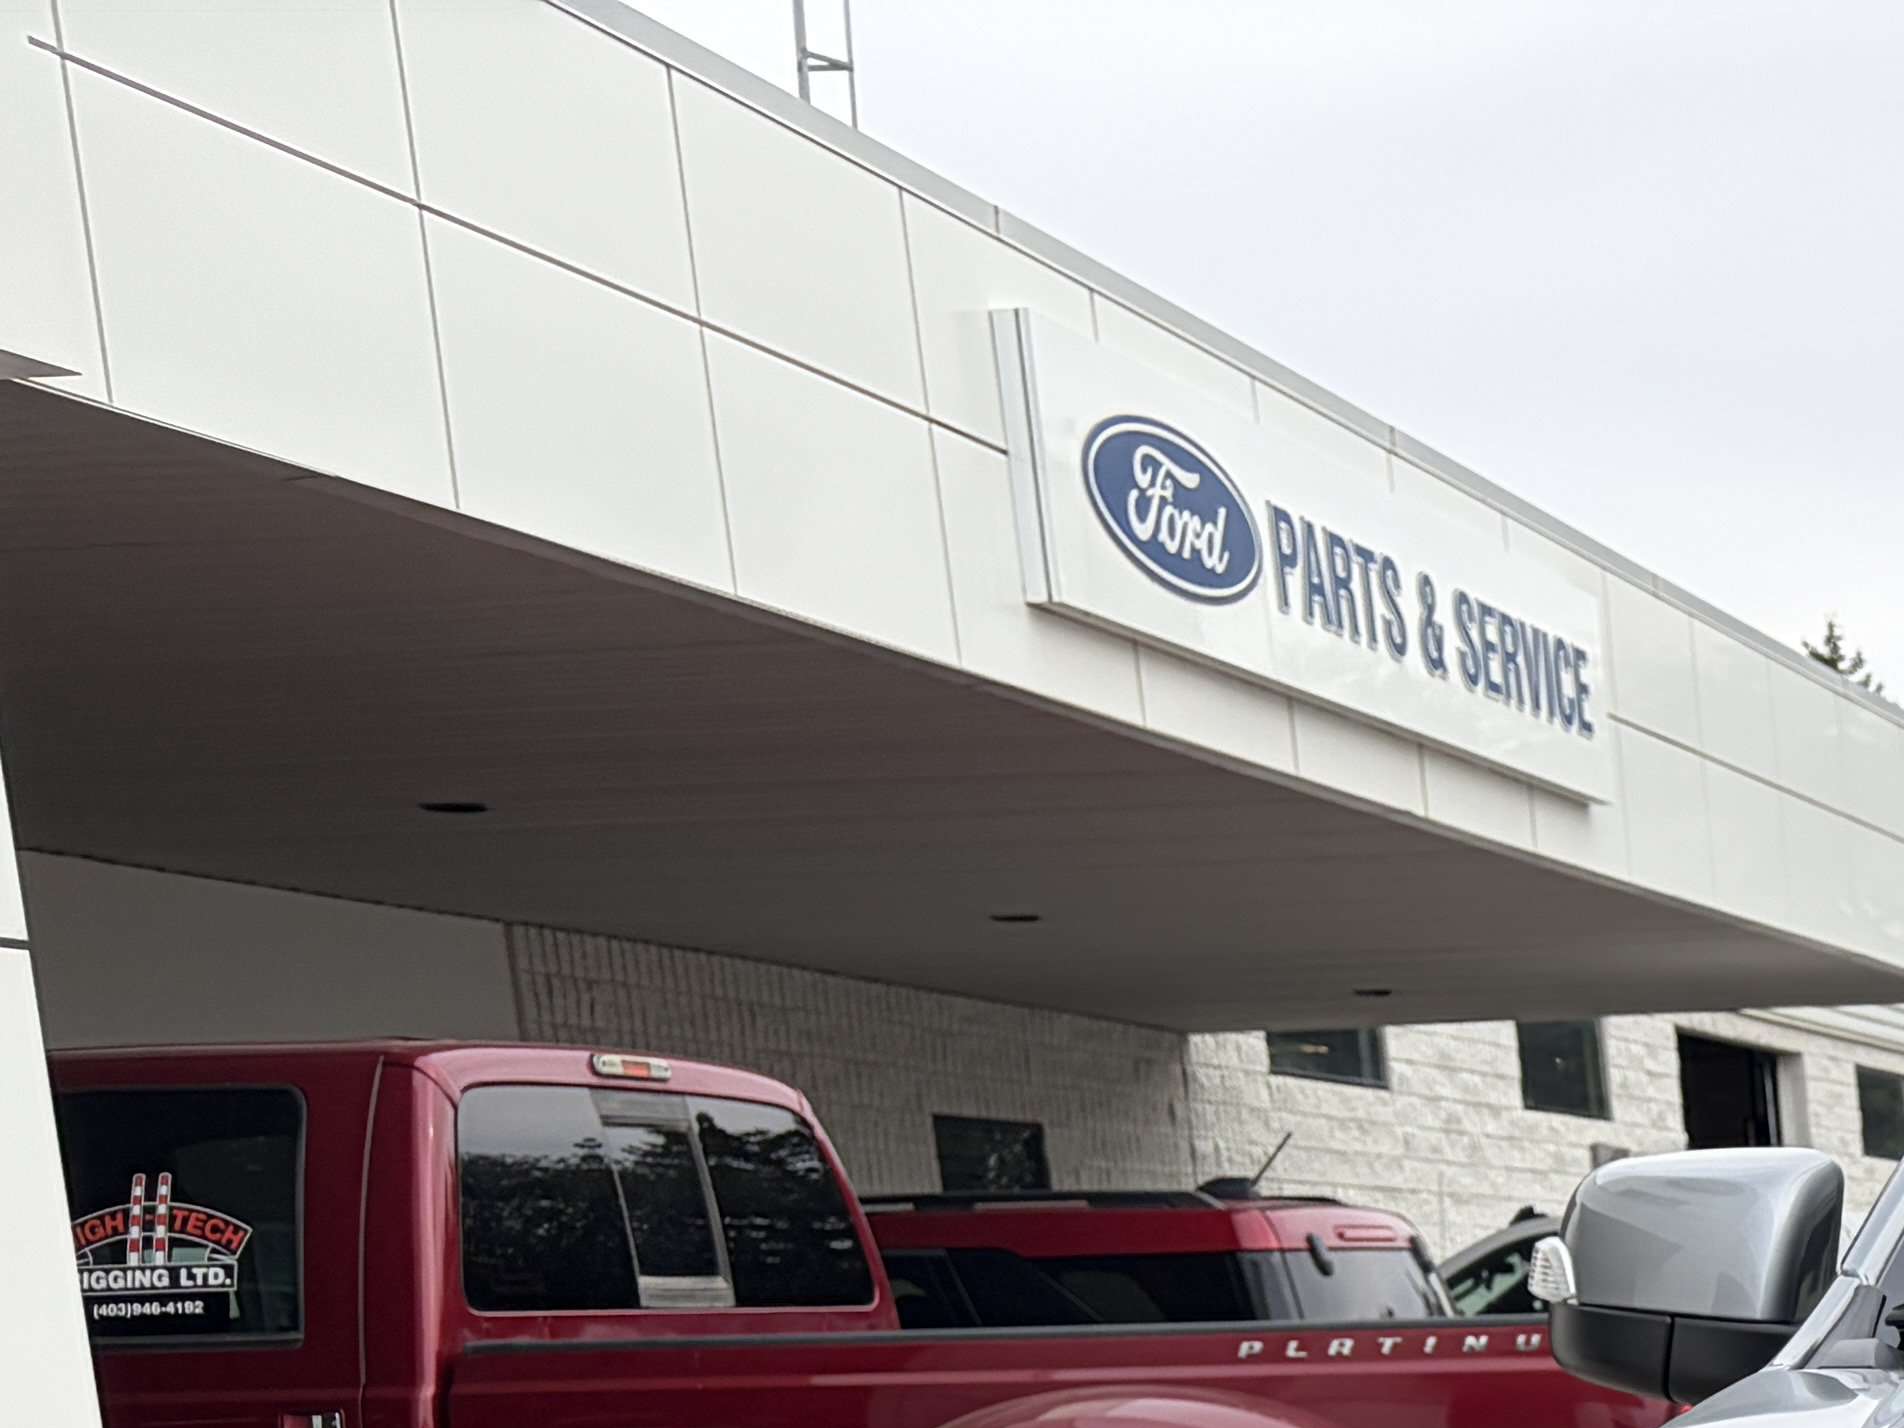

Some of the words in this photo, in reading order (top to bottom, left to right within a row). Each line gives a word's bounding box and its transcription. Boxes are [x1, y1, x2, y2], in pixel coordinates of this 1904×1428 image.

[1127, 444, 1230, 574] Ford
[1265, 499, 1406, 664] PARTS
[1416, 570, 1448, 680] &
[1452, 587, 1594, 740] SERVICE
[74, 1209, 126, 1246] IGH
[80, 1269, 170, 1290] IGGING
[179, 1267, 232, 1286] LTD.
[1237, 1333, 1542, 1359] PLATINU
